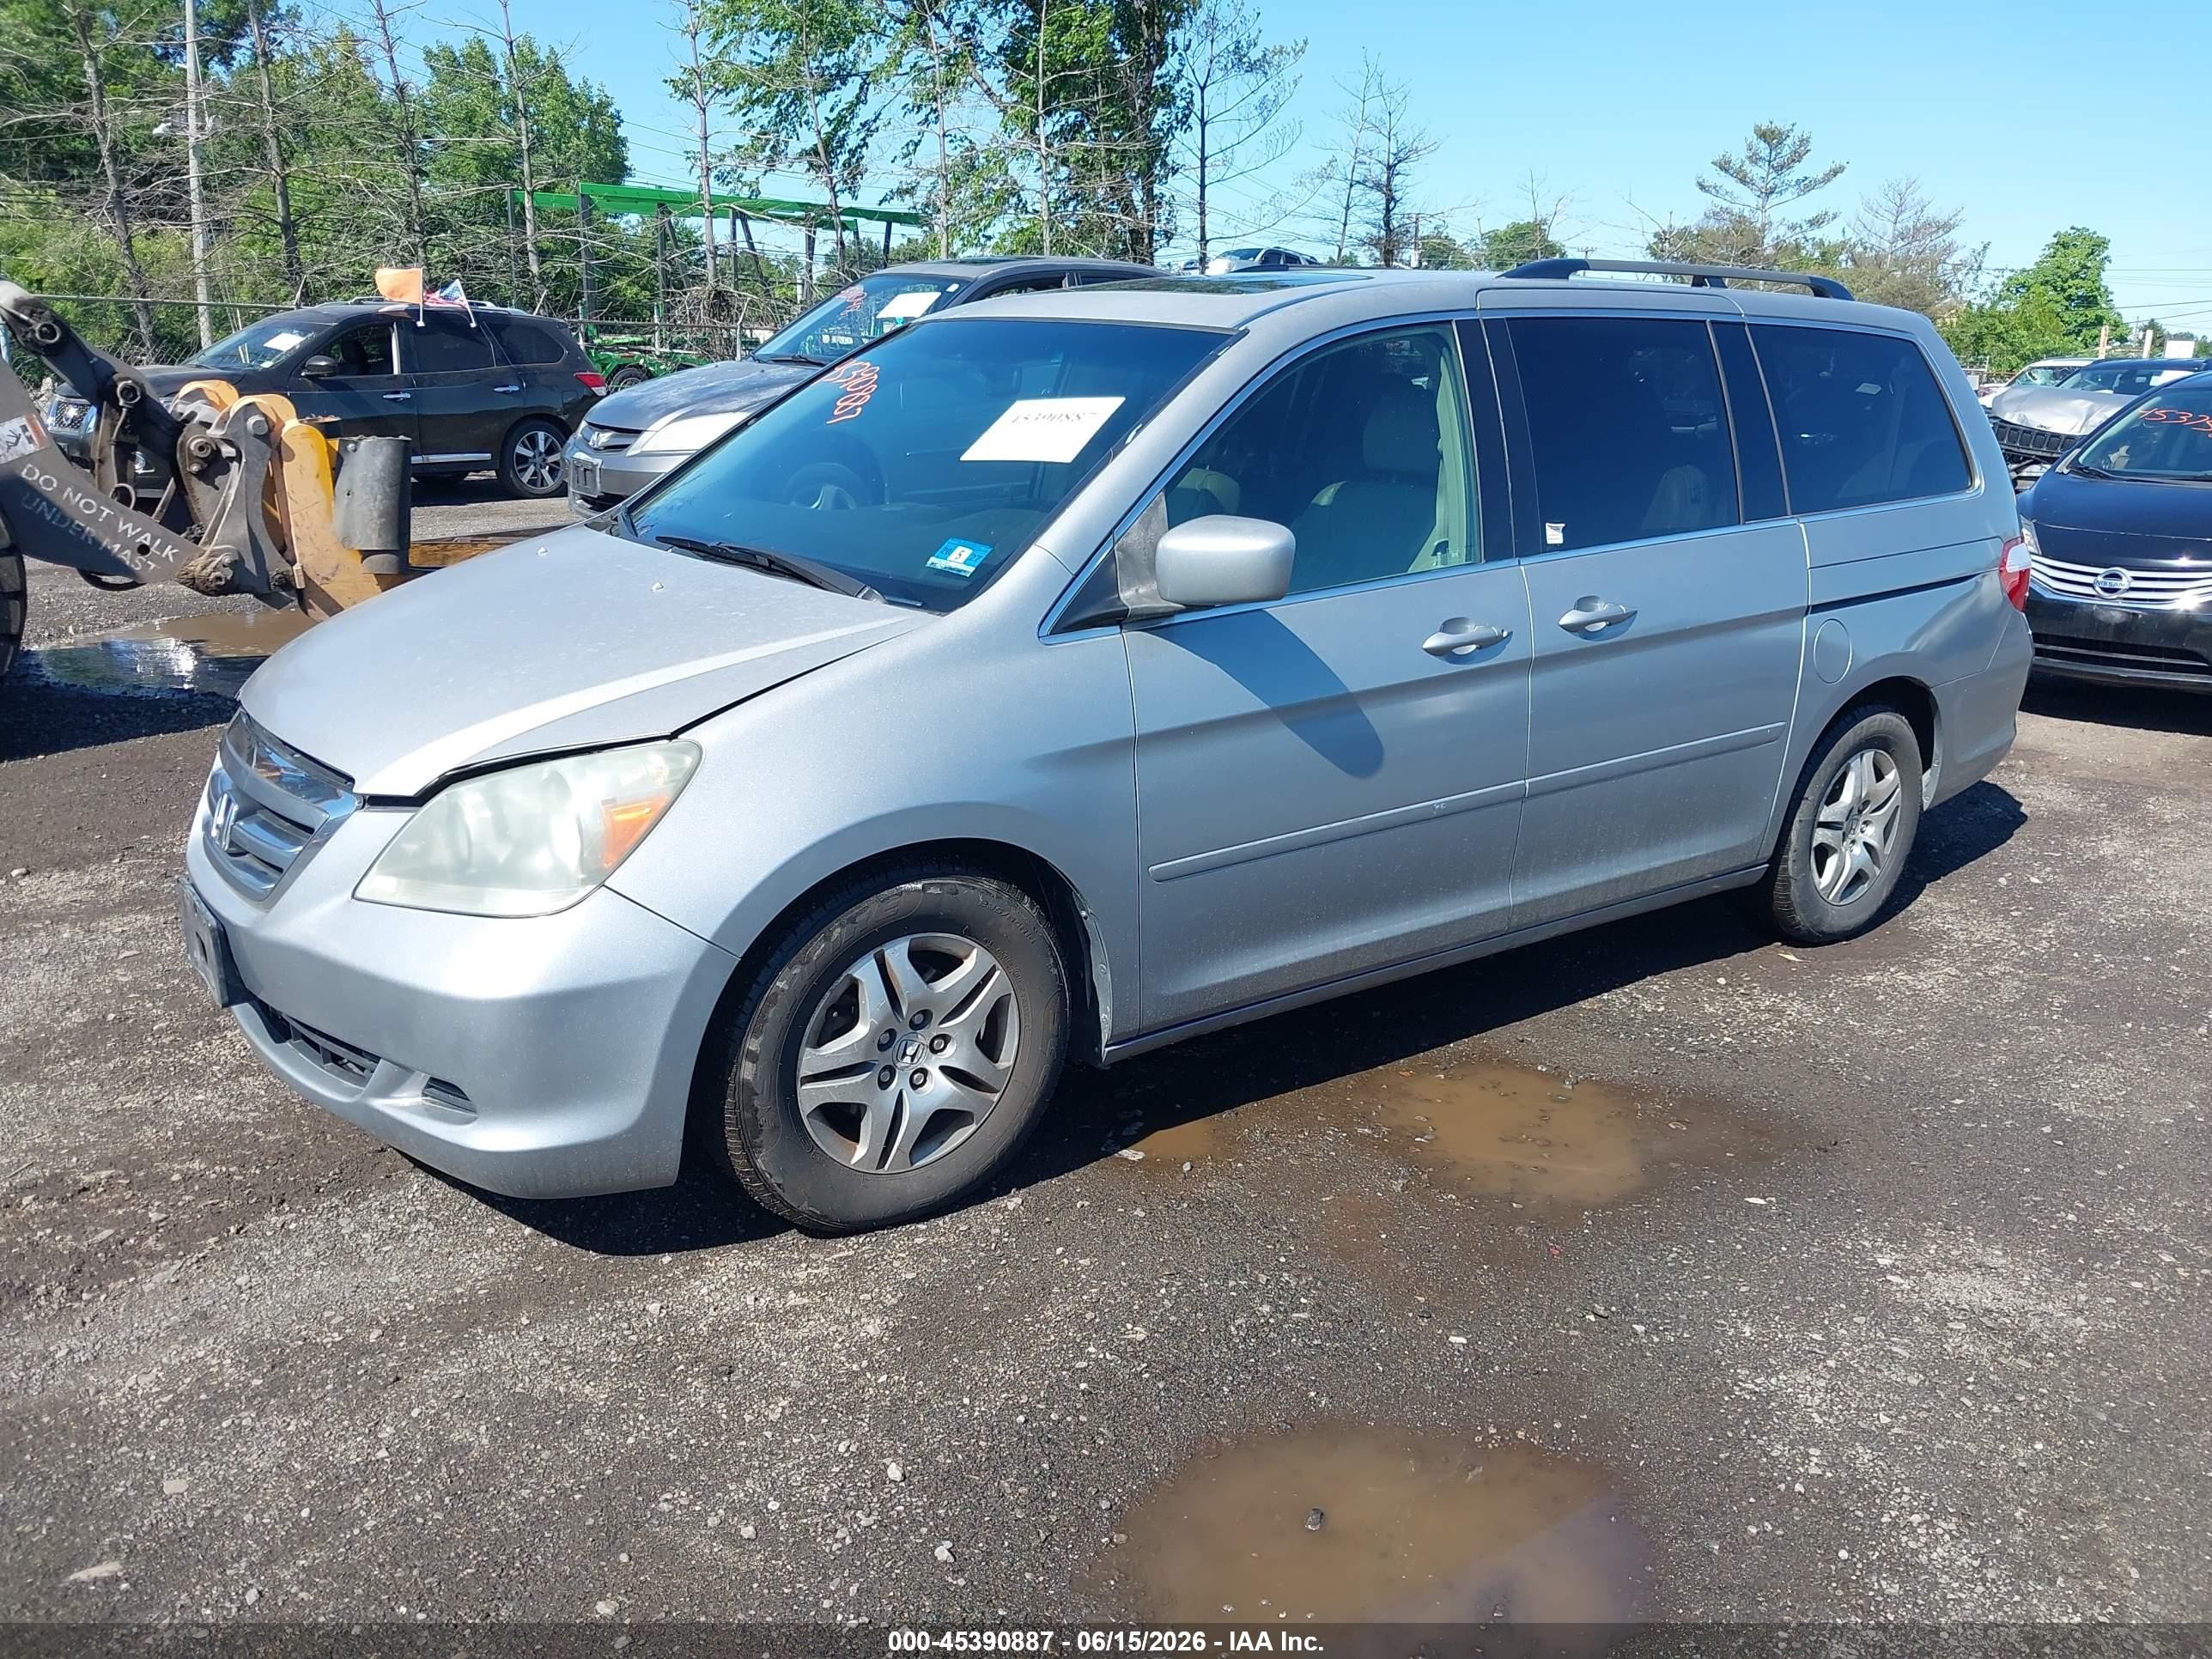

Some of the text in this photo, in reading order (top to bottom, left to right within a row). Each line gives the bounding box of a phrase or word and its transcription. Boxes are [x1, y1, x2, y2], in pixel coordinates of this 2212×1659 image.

[21, 463, 180, 563] DO NOT WALK
[21, 493, 161, 572] UNDER MAST
